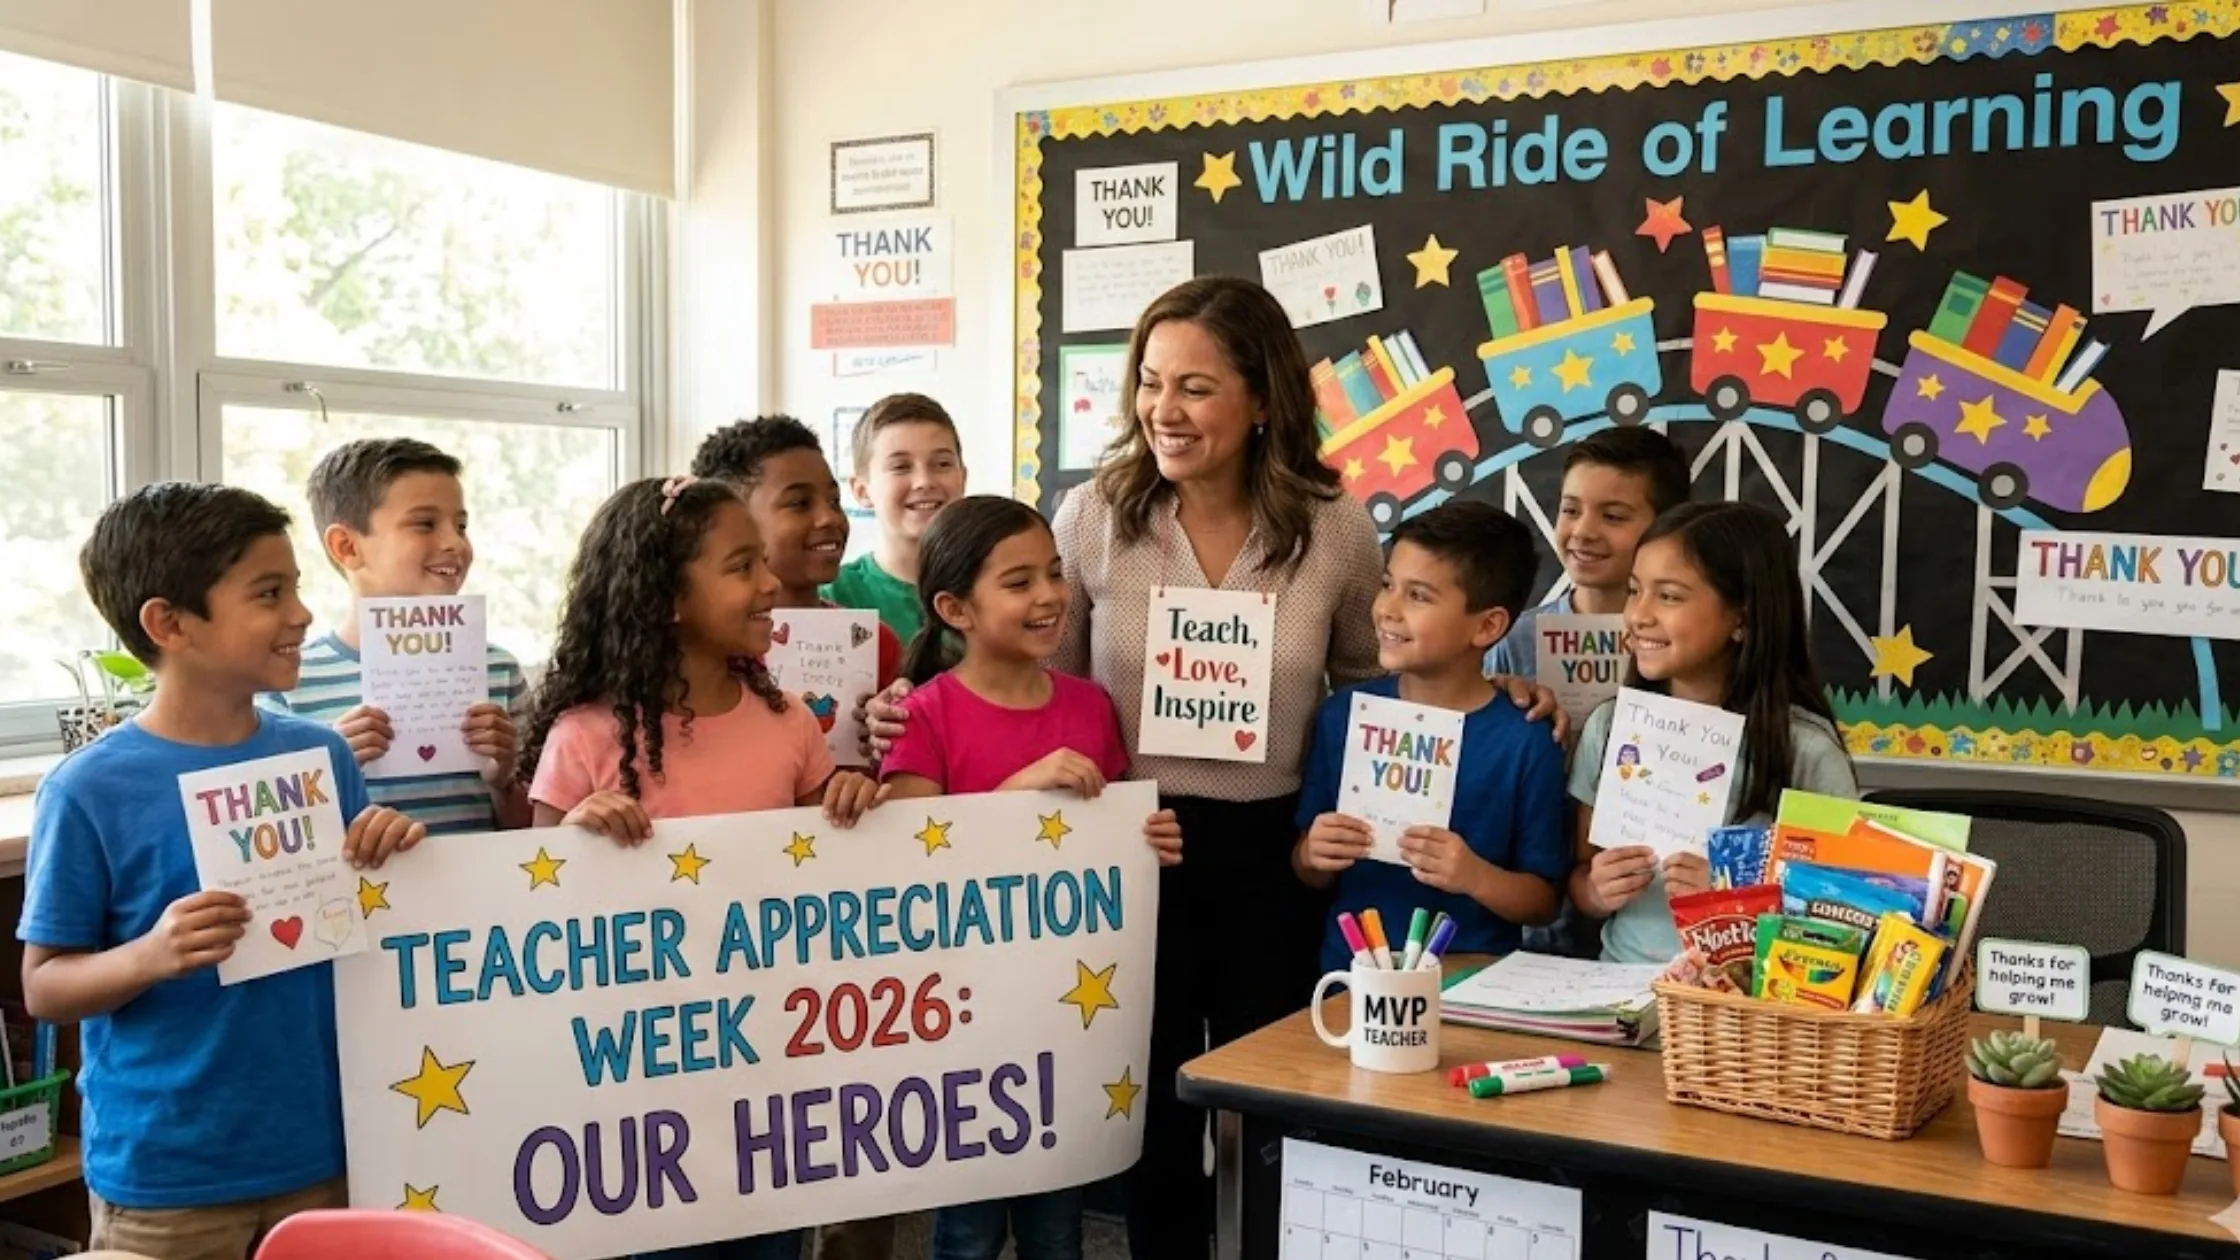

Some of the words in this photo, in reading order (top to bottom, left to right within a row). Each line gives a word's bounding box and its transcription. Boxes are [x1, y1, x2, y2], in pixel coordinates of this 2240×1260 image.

[1249, 129, 1404, 204] Wild
[1436, 115, 1608, 191] Ride
[1642, 101, 1728, 178] of
[1764, 73, 2183, 168] Learning
[1091, 176, 1166, 202] THANK
[1102, 205, 1154, 230] YOU!
[2101, 202, 2196, 237] THANK
[2204, 197, 2240, 227] YO
[835, 226, 933, 258] THANK
[1267, 245, 1321, 276] THANK
[1325, 232, 1366, 262] YOU!
[854, 260, 921, 288] YOU!
[2032, 541, 2162, 584] THANK
[369, 603, 465, 629] THANK
[1166, 607, 1258, 649] Teach,
[385, 630, 453, 657] YOU!
[1173, 646, 1248, 689] Love,
[1153, 684, 1260, 729] Inspire
[1628, 702, 1692, 737] Thank
[1701, 724, 1733, 748] You
[1358, 723, 1455, 768] THANK
[195, 768, 330, 826] THANK
[1372, 759, 1433, 797] YOU!
[228, 814, 317, 865] YOU!
[381, 908, 692, 1009] TEACHER
[715, 865, 1125, 974] APPRECIATION
[1988, 968, 2046, 989] helping
[2050, 976, 2075, 990] me
[1990, 950, 2045, 970] Thanks
[2050, 955, 2076, 971] for
[2147, 963, 2204, 989] Thanks
[1363, 994, 1428, 1027] MVP
[2008, 991, 2055, 1006] grow!
[2160, 1005, 2210, 1028] grow!
[571, 994, 761, 1087] WEEK
[783, 972, 974, 1059] 2026:
[1363, 1027, 1428, 1048] TEACHER
[512, 1108, 699, 1226] OUR
[733, 1050, 1059, 1195] HEROES!
[1369, 1163, 1480, 1208] February
